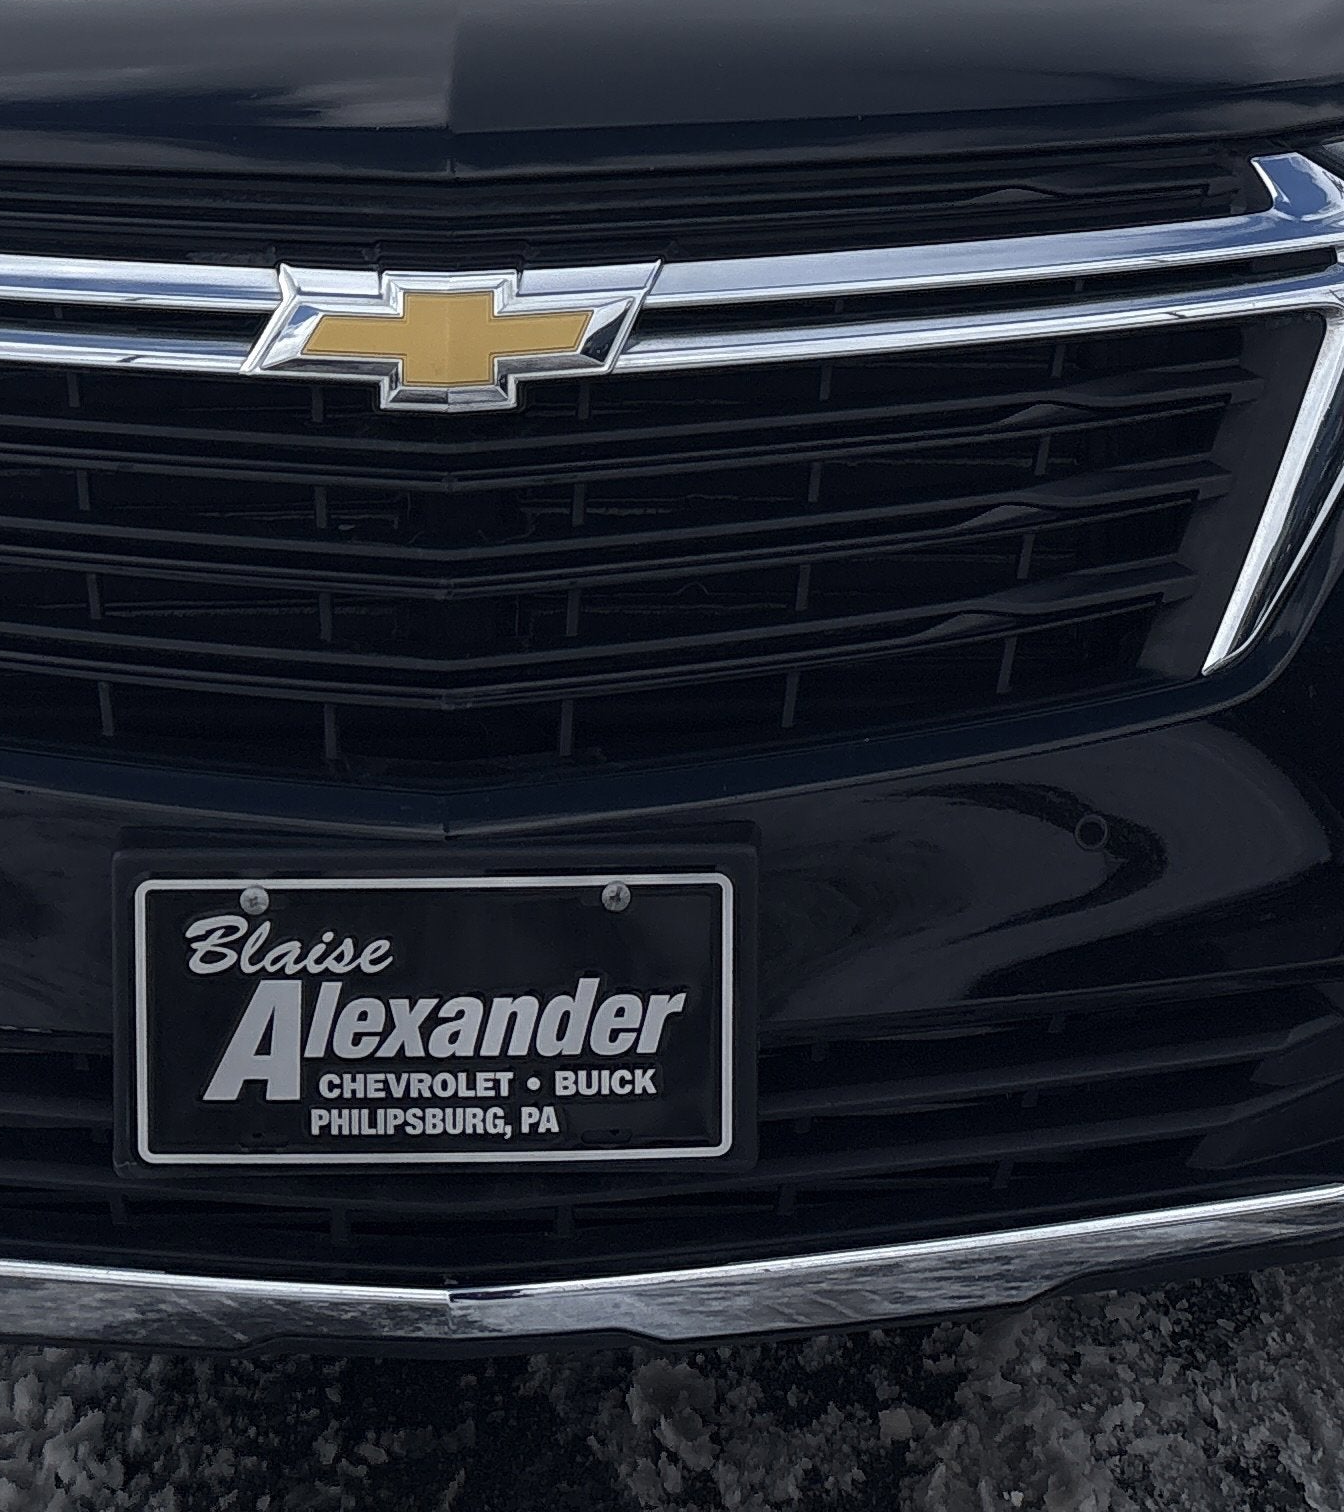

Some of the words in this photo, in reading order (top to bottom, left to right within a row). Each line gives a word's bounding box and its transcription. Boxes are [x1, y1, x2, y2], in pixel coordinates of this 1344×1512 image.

[184, 915, 394, 975] Blaise
[202, 977, 687, 1102] Alexander
[318, 1072, 514, 1099] CHEVROLET
[555, 1069, 658, 1097] BUICK
[310, 1106, 513, 1139] PHILIPSBURG,
[520, 1106, 560, 1134] PA
